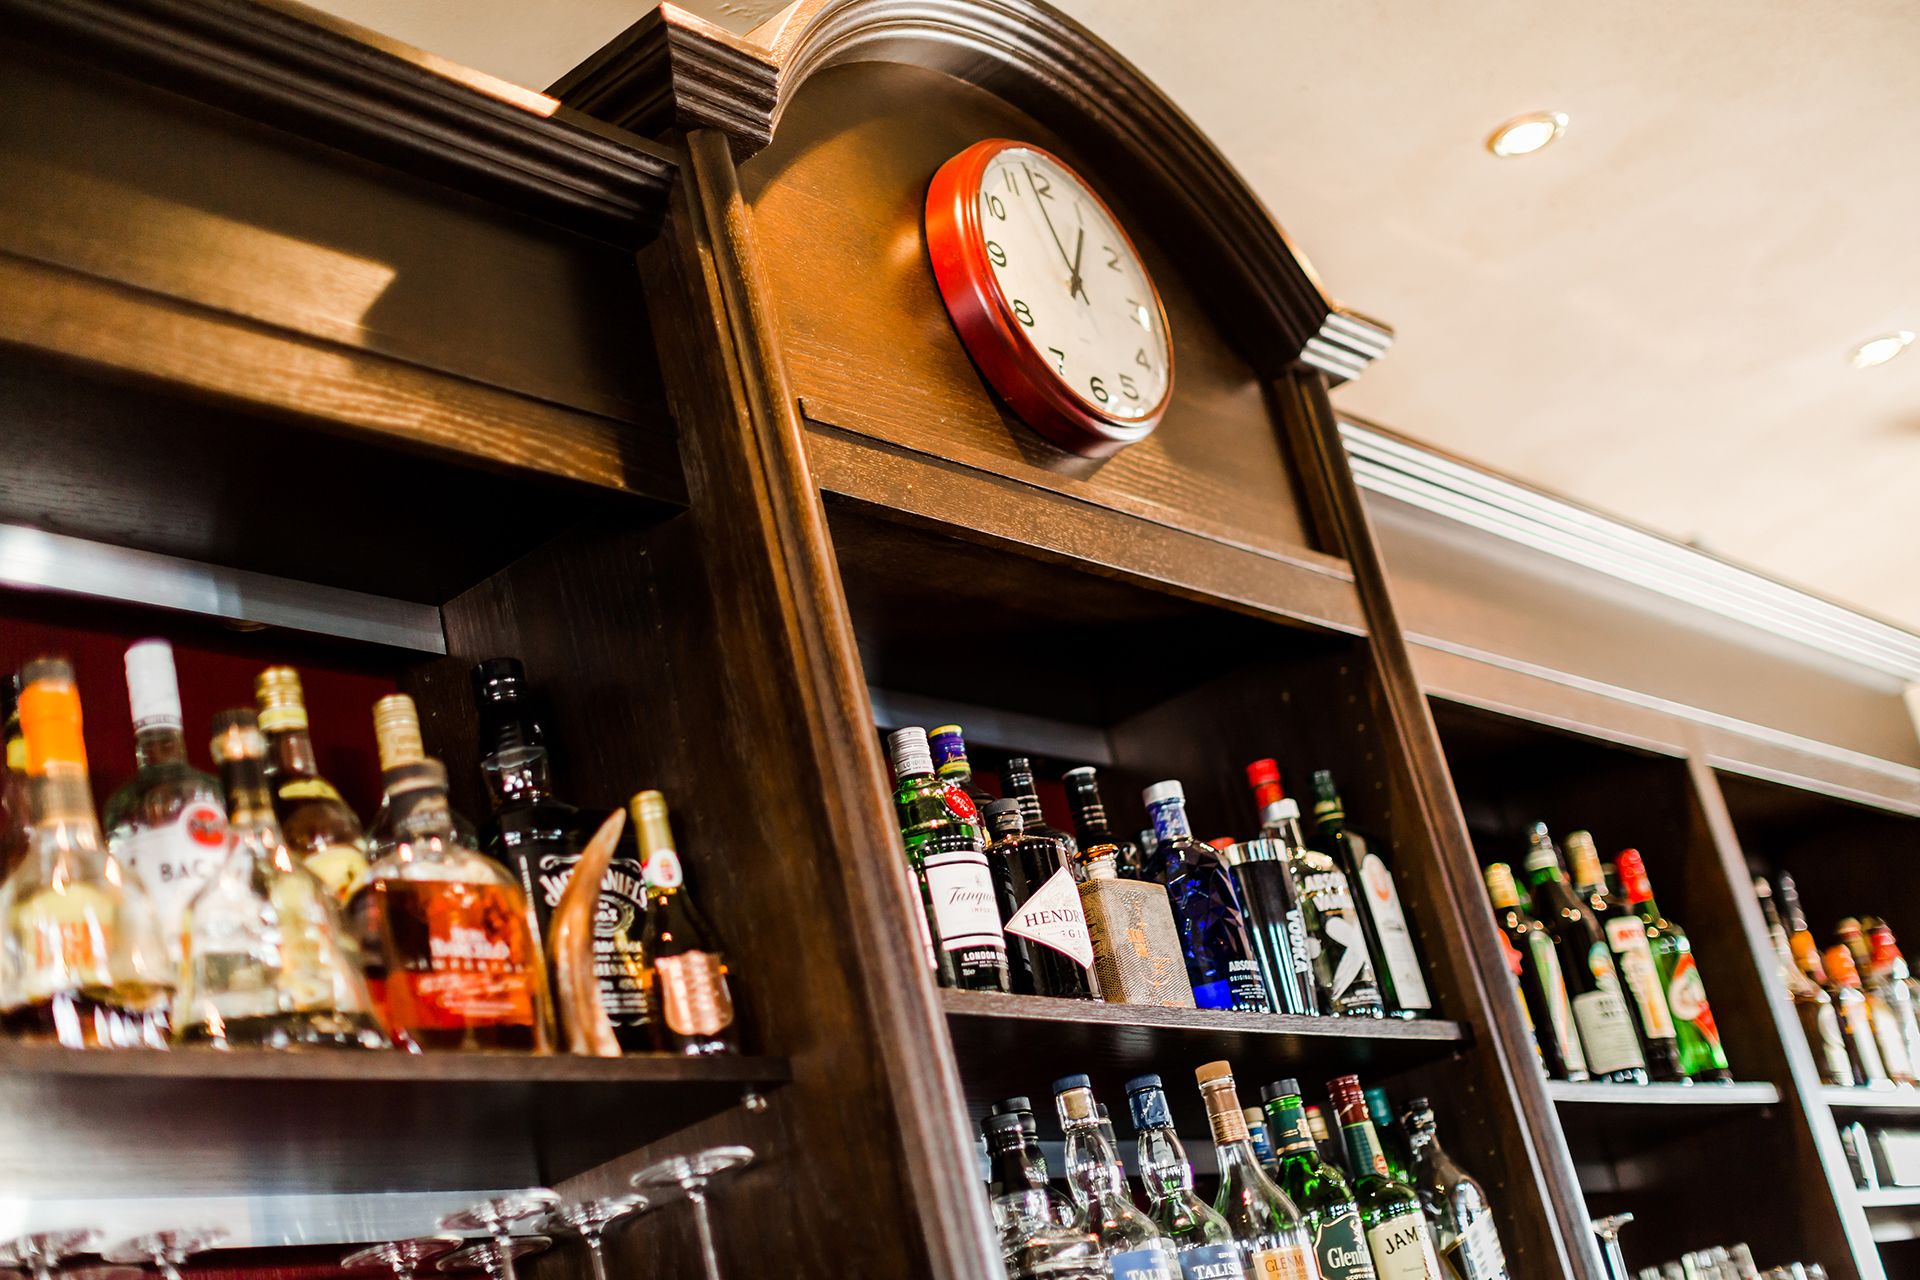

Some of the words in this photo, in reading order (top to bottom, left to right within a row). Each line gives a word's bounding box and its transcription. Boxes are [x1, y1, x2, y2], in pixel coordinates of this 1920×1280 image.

[1001, 167, 1020, 197] 11
[984, 191, 1006, 222] 10
[987, 240, 1007, 268] 9
[1103, 246, 1123, 272] 2
[1013, 299, 1035, 327] 8
[1048, 346, 1065, 376] 7
[1090, 377, 1109, 403] 6
[1118, 373, 1139, 400] 5
[963, 951, 996, 962] LONDON
